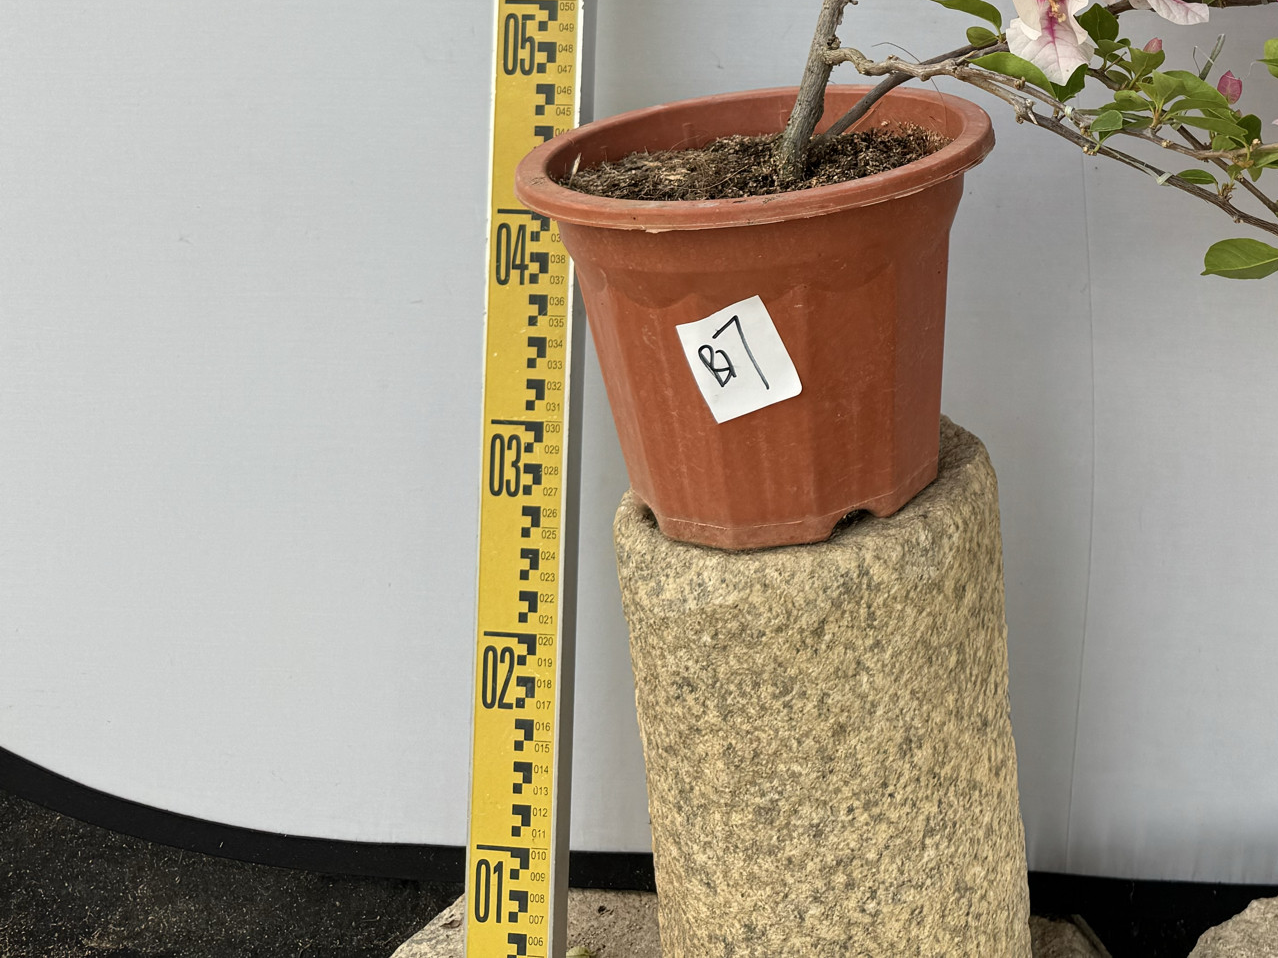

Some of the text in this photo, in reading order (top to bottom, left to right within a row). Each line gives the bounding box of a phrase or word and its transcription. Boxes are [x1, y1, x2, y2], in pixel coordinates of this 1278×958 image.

[560, 2, 574, 11] 050
[559, 23, 574, 32] 049
[503, 13, 535, 76] 05
[558, 44, 573, 53] 048
[557, 65, 572, 74] 047
[557, 86, 572, 95] 046
[556, 107, 571, 116] 045
[496, 223, 529, 285] 04
[550, 254, 565, 263] 038
[550, 276, 564, 284] 037
[549, 297, 564, 306] 036
[549, 318, 564, 327] 035
[548, 339, 563, 348] 034
[547, 361, 562, 369] 033
[547, 381, 561, 390] 032
[546, 402, 560, 411] 031
[545, 424, 560, 432] 030
[544, 445, 559, 454] 029
[489, 433, 521, 497] 03
[544, 466, 558, 475] 028
[543, 488, 558, 496] 027
[542, 508, 557, 517] 026
[542, 530, 556, 539] 025
[541, 551, 555, 560] 024
[540, 573, 555, 582] 023
[540, 594, 554, 603] 022
[539, 615, 553, 624] 021
[538, 637, 553, 646] 020
[538, 658, 552, 667] 019
[482, 645, 514, 709] 02
[537, 679, 551, 688] 018
[536, 701, 551, 709] 017
[535, 722, 550, 731] 016
[535, 743, 550, 753] 015
[534, 765, 549, 774] 014
[533, 786, 548, 795] 013
[533, 808, 548, 817] 012
[532, 829, 545, 838] 011
[531, 851, 546, 860] 010
[530, 872, 545, 881] 009
[475, 859, 503, 923] 01
[530, 894, 544, 903] 008
[529, 915, 544, 924] 007
[528, 937, 543, 946] 006
